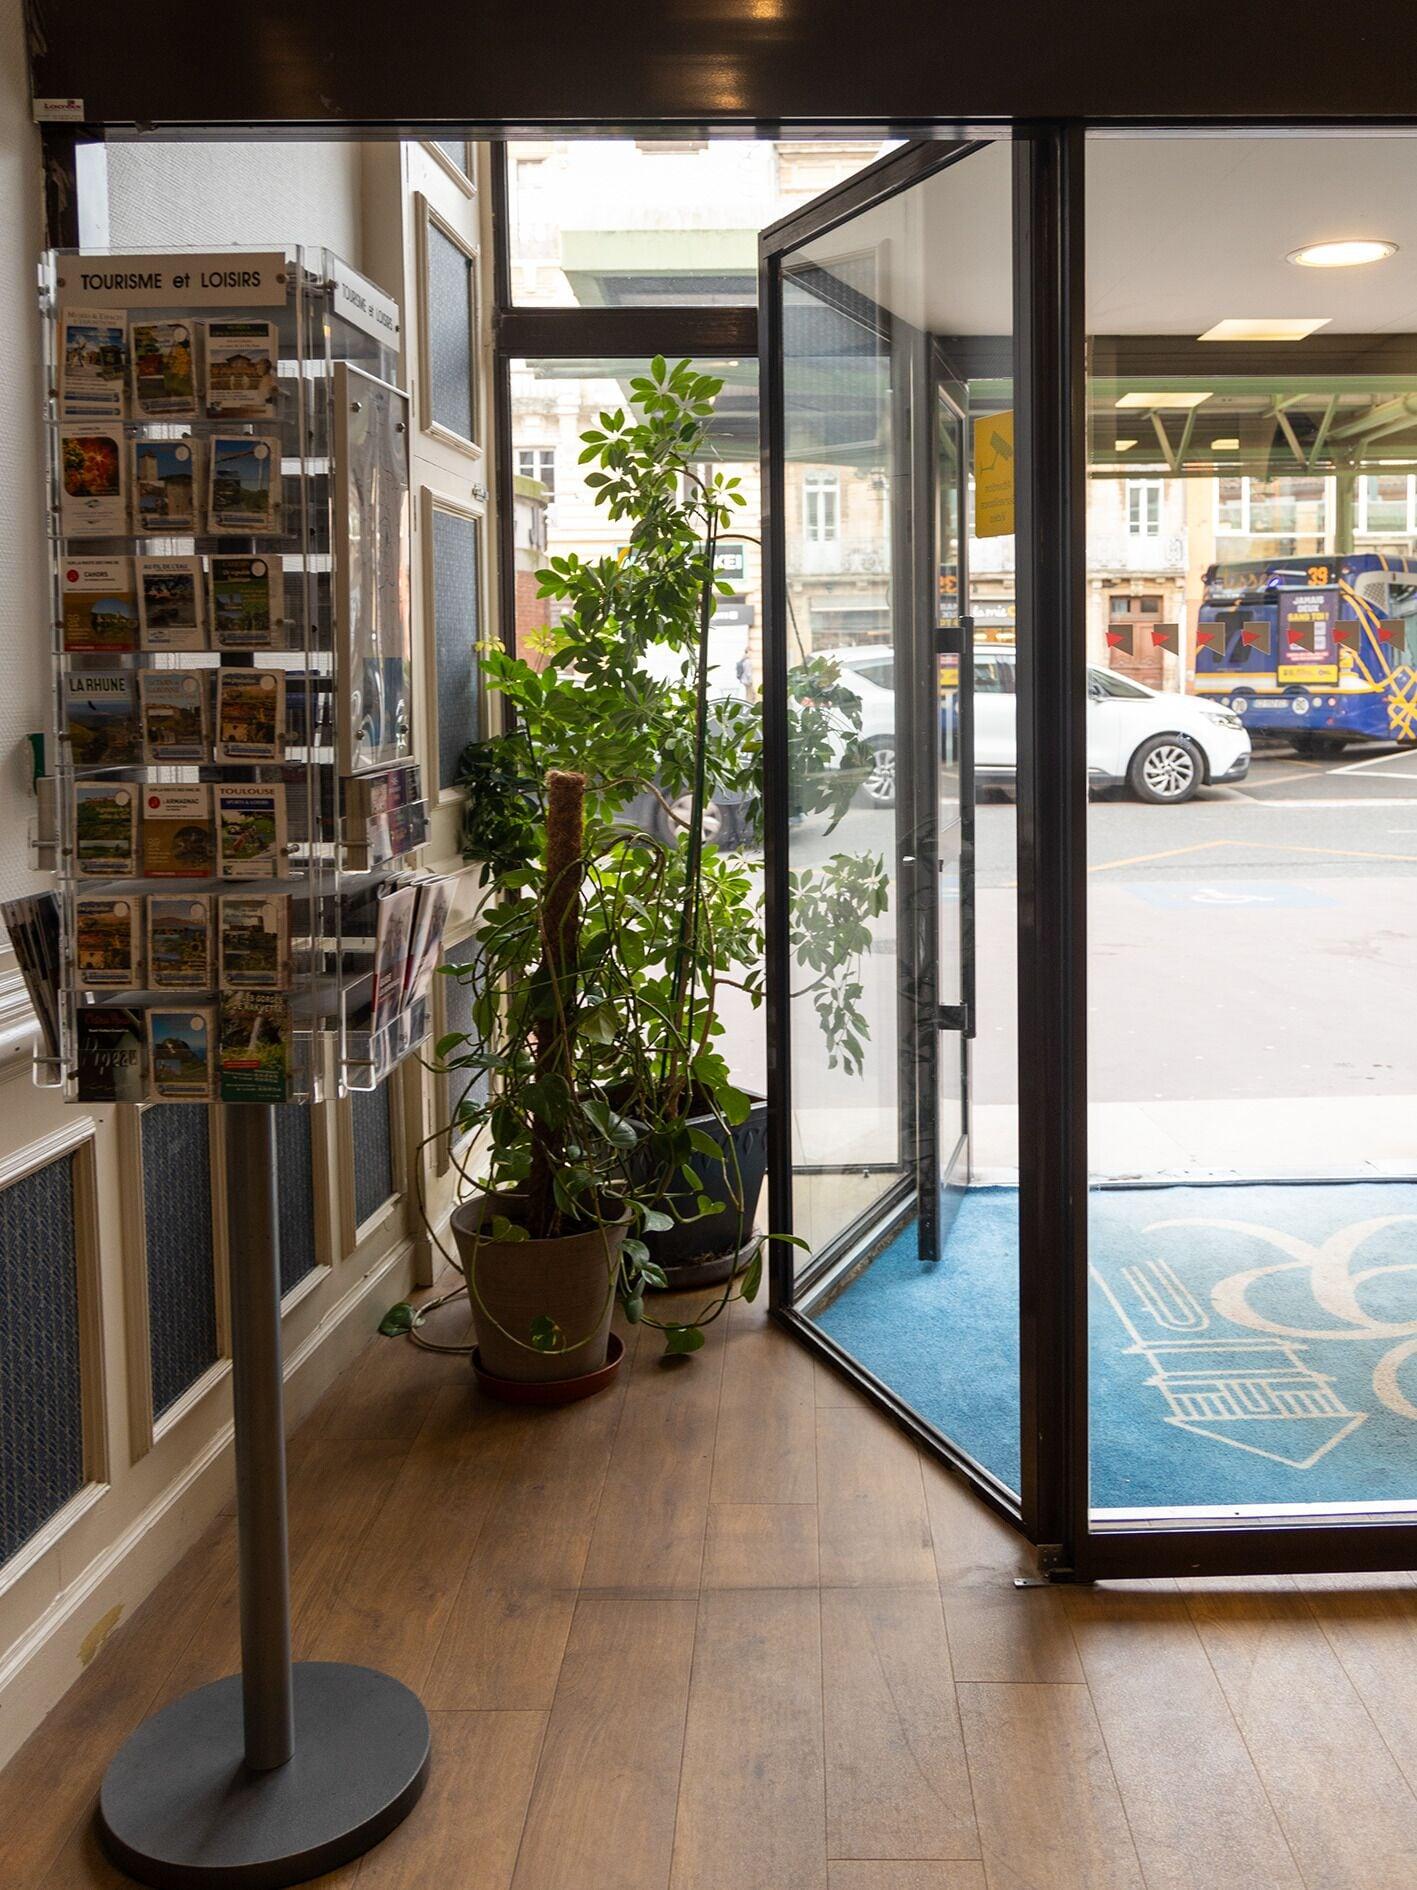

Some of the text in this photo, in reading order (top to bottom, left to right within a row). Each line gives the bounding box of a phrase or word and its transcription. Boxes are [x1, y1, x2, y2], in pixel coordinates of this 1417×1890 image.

[81, 272, 261, 290] TOURISME et LOISIRS
[342, 282, 367, 313] TOURISME
[1307, 565, 1329, 586] 39
[69, 678, 126, 692] LA RHUNE
